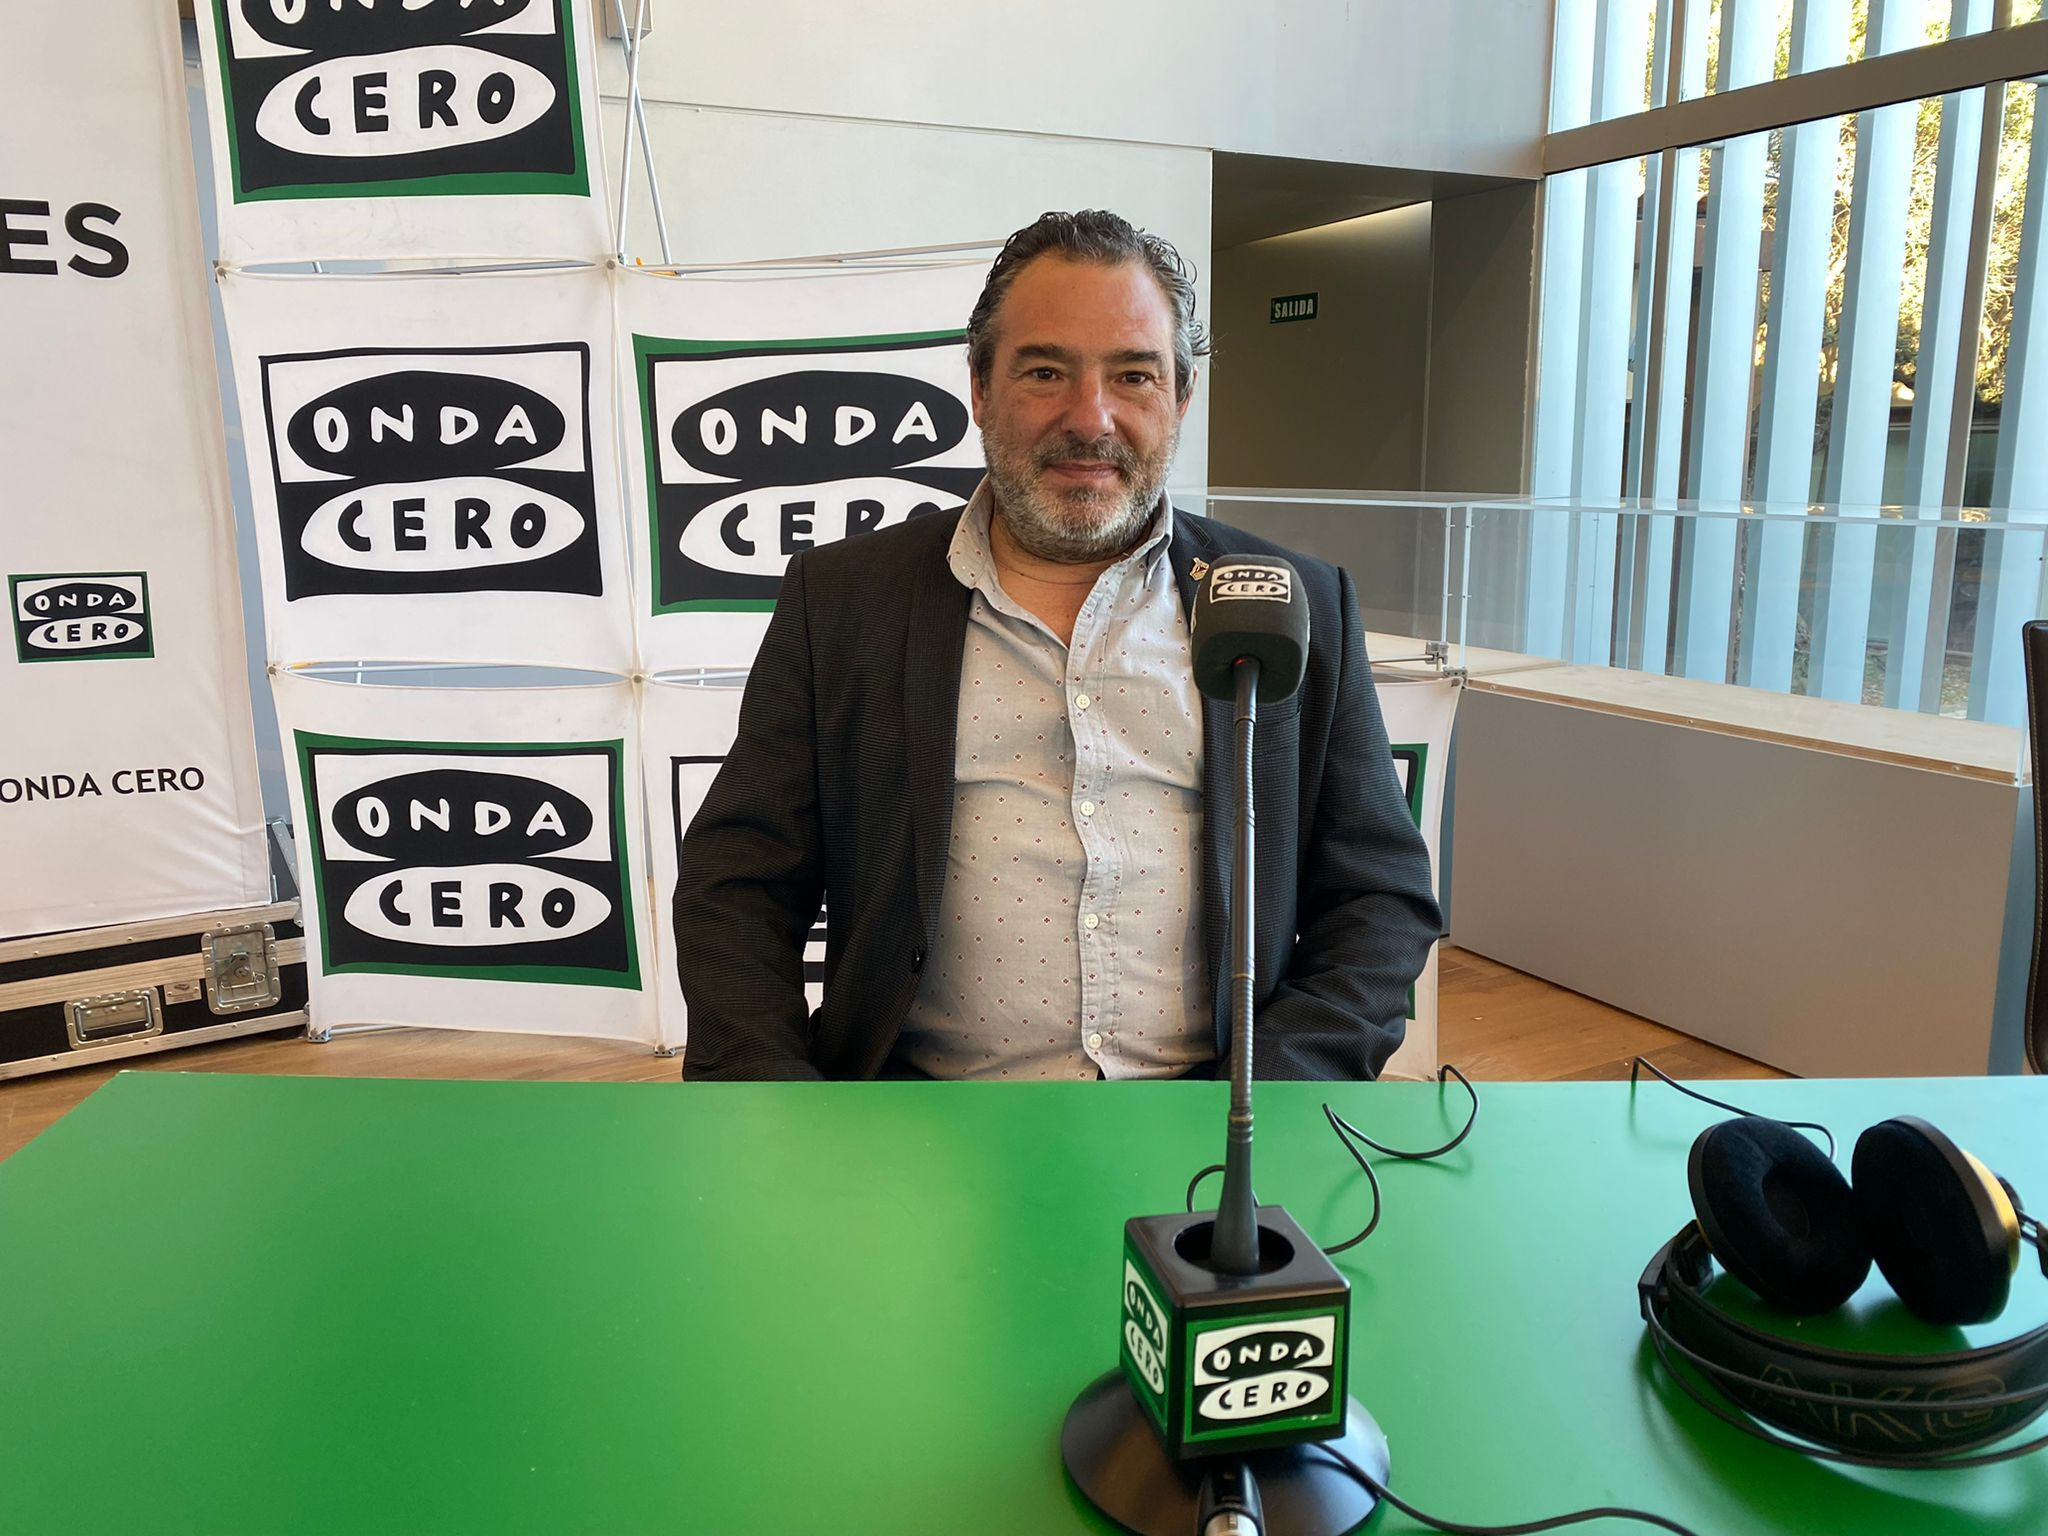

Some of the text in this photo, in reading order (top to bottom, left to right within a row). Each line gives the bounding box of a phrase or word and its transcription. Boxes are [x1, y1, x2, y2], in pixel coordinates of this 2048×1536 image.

[294, 69, 515, 136] CERO
[1274, 298, 1314, 319] SALIDA
[313, 403, 538, 453] ONDA
[700, 401, 938, 456] ONDA
[337, 497, 547, 552] CERO
[1223, 571, 1279, 580] ONDA
[1227, 584, 1279, 593] CERO
[34, 592, 126, 611] ONDA
[43, 622, 129, 643] CERO
[0, 766, 205, 804] ONDA CERO
[356, 796, 567, 838] ONDA
[379, 879, 576, 929] CERO
[1129, 1284, 1161, 1347] ONDA
[1129, 1327, 1160, 1385] CERO
[1213, 1338, 1314, 1371] ONDA
[1218, 1380, 1312, 1411] CERO
